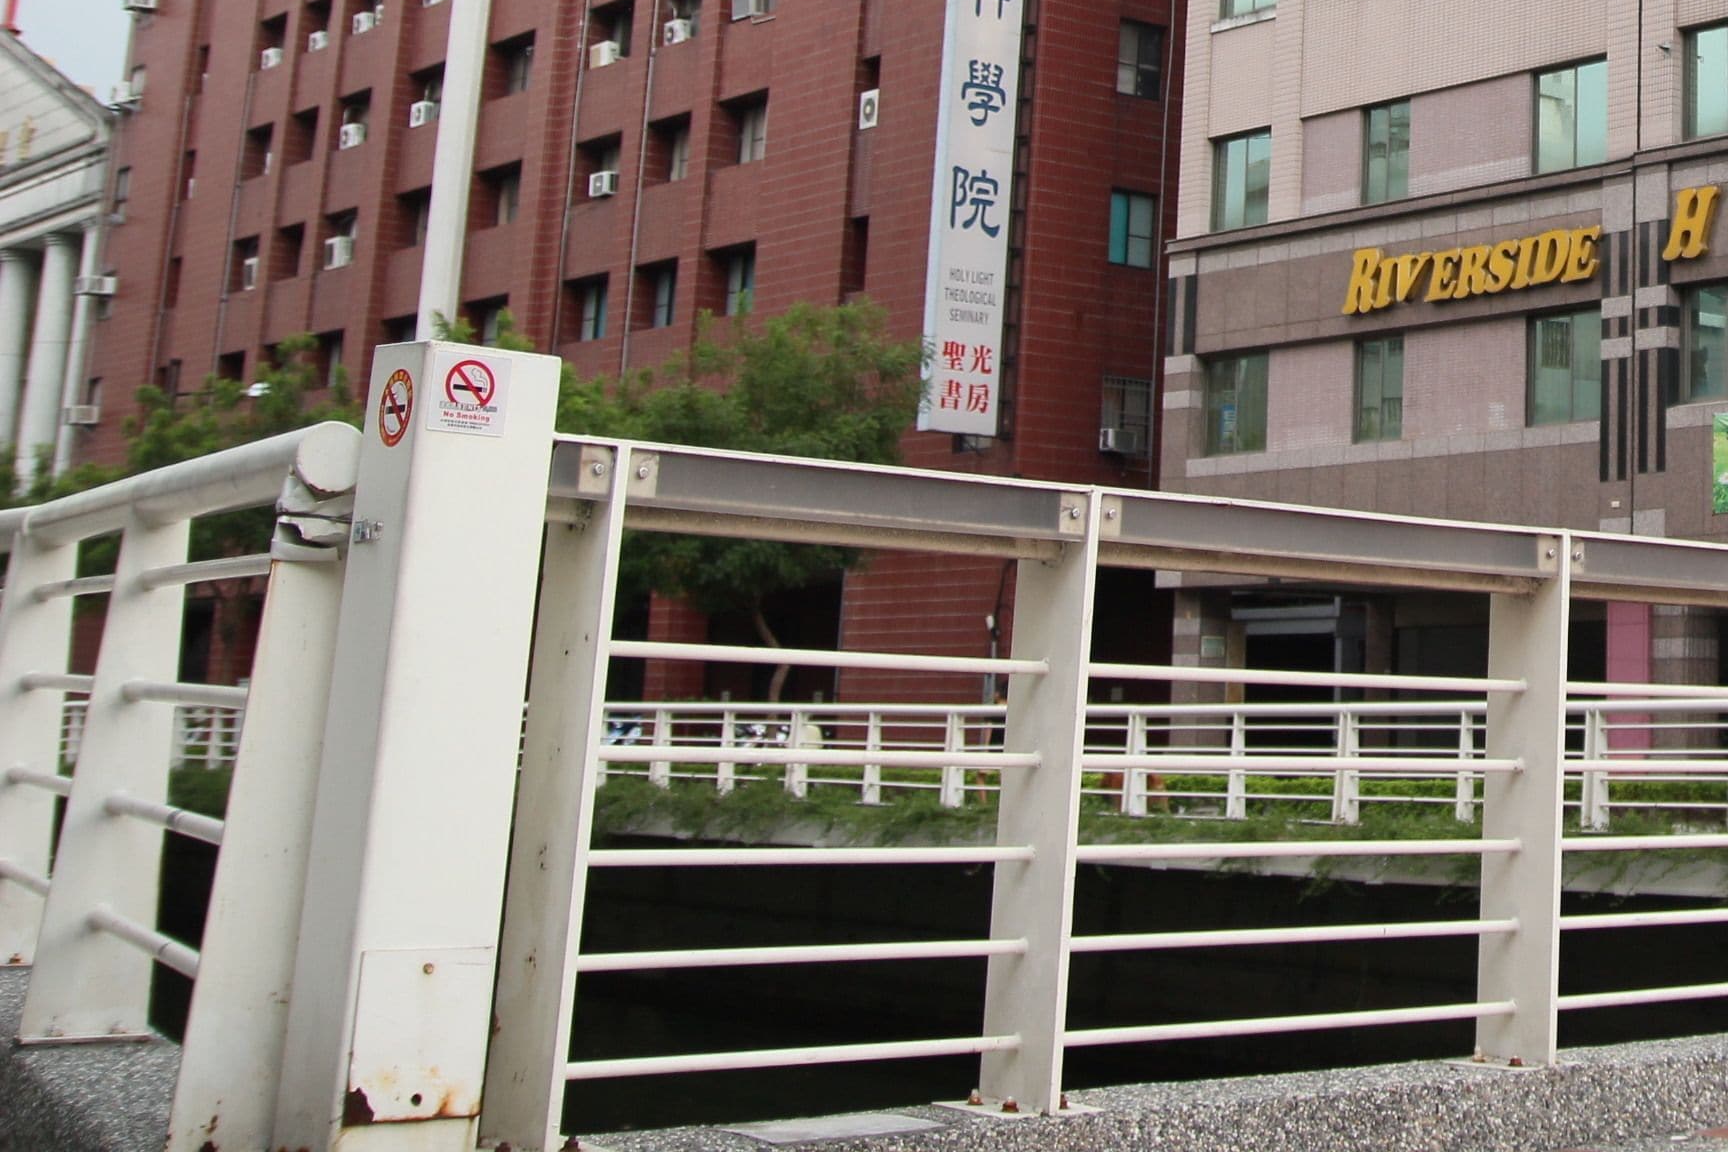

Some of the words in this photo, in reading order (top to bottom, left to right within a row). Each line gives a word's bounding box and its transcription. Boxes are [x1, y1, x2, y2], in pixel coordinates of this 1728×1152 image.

[949, 268, 970, 284] HOLY
[971, 271, 995, 286] LIGHT
[1341, 224, 1603, 316] RIVERSIDE
[944, 287, 997, 307] THEOLOGICAL
[949, 308, 989, 325] SEMINARY
[942, 340, 993, 375] 聖光
[939, 379, 991, 414] 書房
[443, 410, 455, 418] No
[456, 412, 490, 422] Smoking
